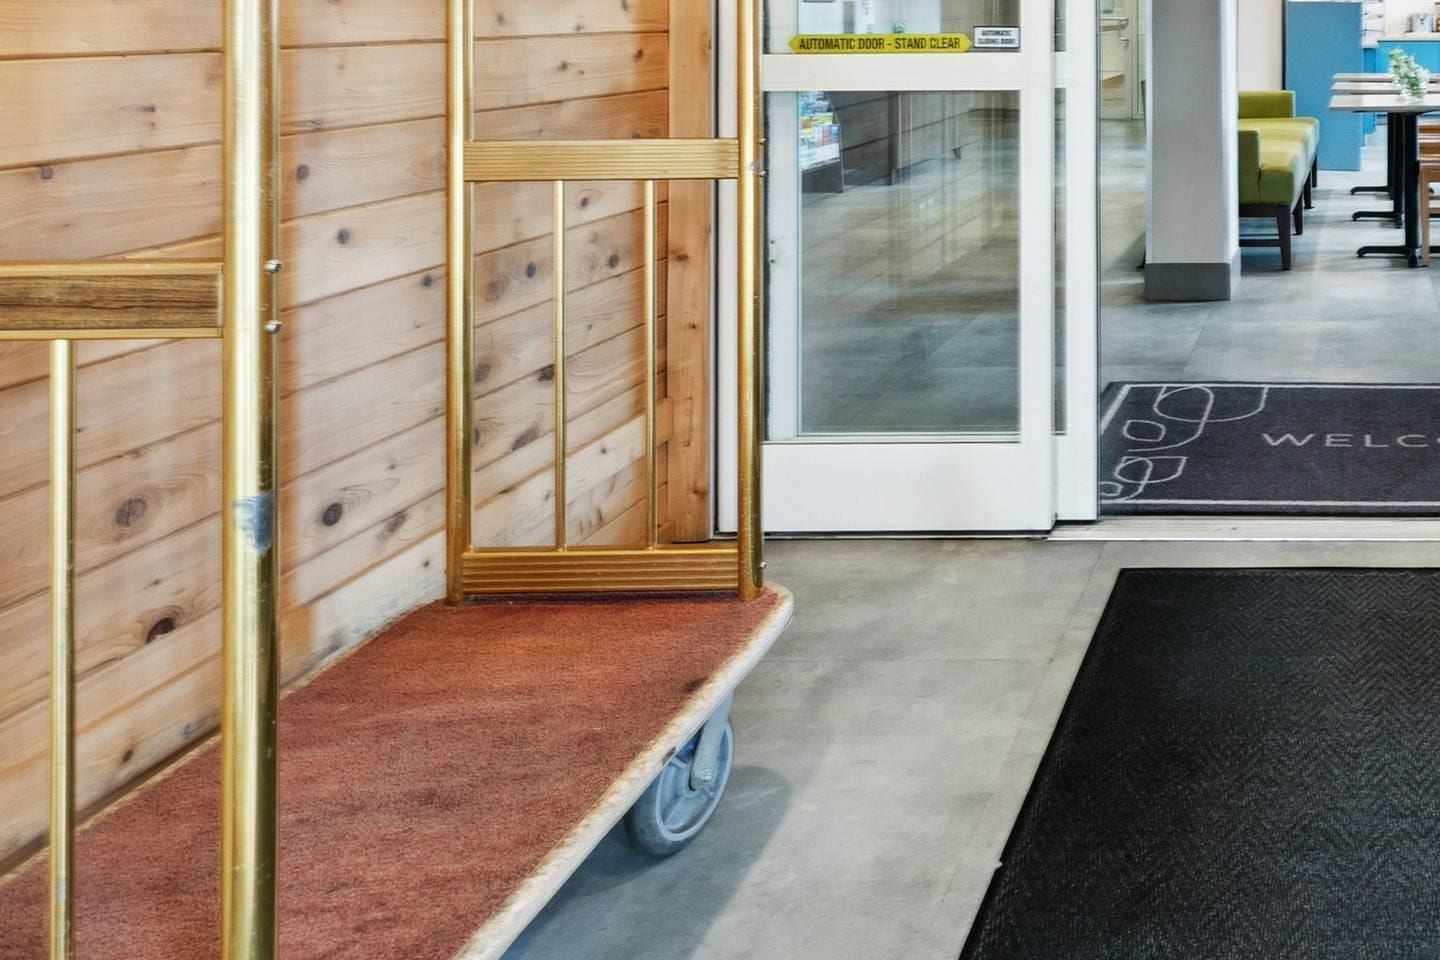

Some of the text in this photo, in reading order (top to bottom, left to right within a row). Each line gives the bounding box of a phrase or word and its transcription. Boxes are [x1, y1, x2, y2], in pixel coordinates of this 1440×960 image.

[799, 38, 855, 50] AUTOMATIC
[858, 38, 885, 50] DOOR
[895, 37, 927, 49] STAND
[929, 37, 961, 49] CLEAR
